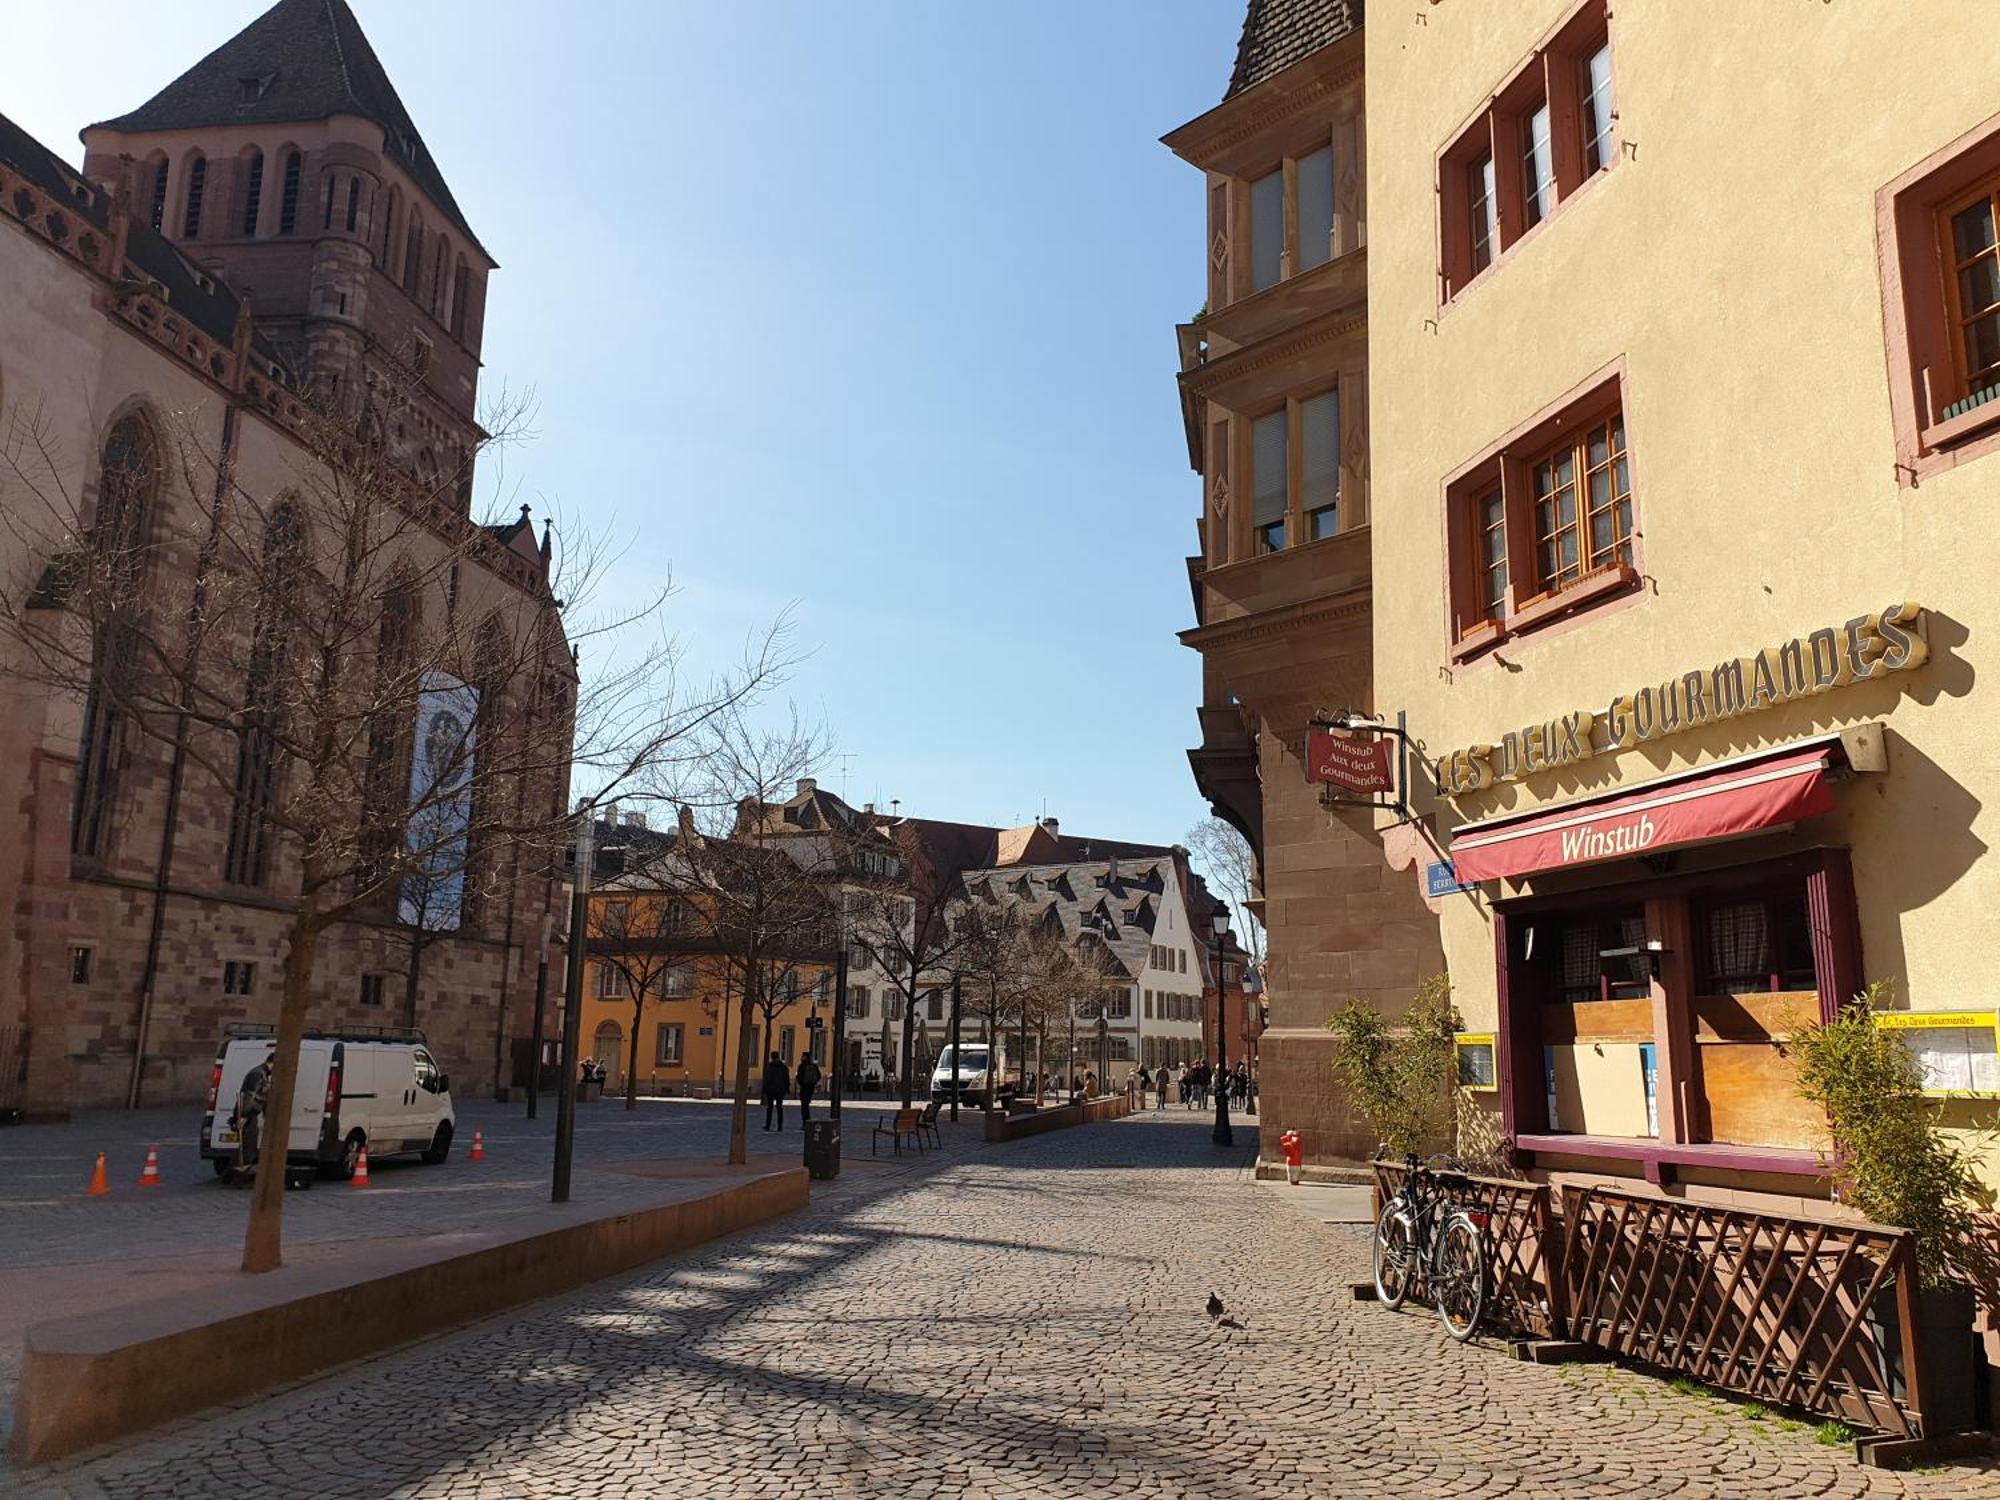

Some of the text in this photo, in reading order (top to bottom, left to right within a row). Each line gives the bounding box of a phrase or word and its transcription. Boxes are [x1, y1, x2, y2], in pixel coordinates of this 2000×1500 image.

[1501, 711, 1583, 779] DEUX
[1607, 603, 1914, 748] GOURMANDES
[1332, 739, 1373, 757] Winstub
[1330, 752, 1377, 771] Aux deux
[1320, 765, 1385, 786] Gourmandes
[1562, 814, 1655, 863] Winstub
[1928, 1015, 1976, 1026] Gourmandes
